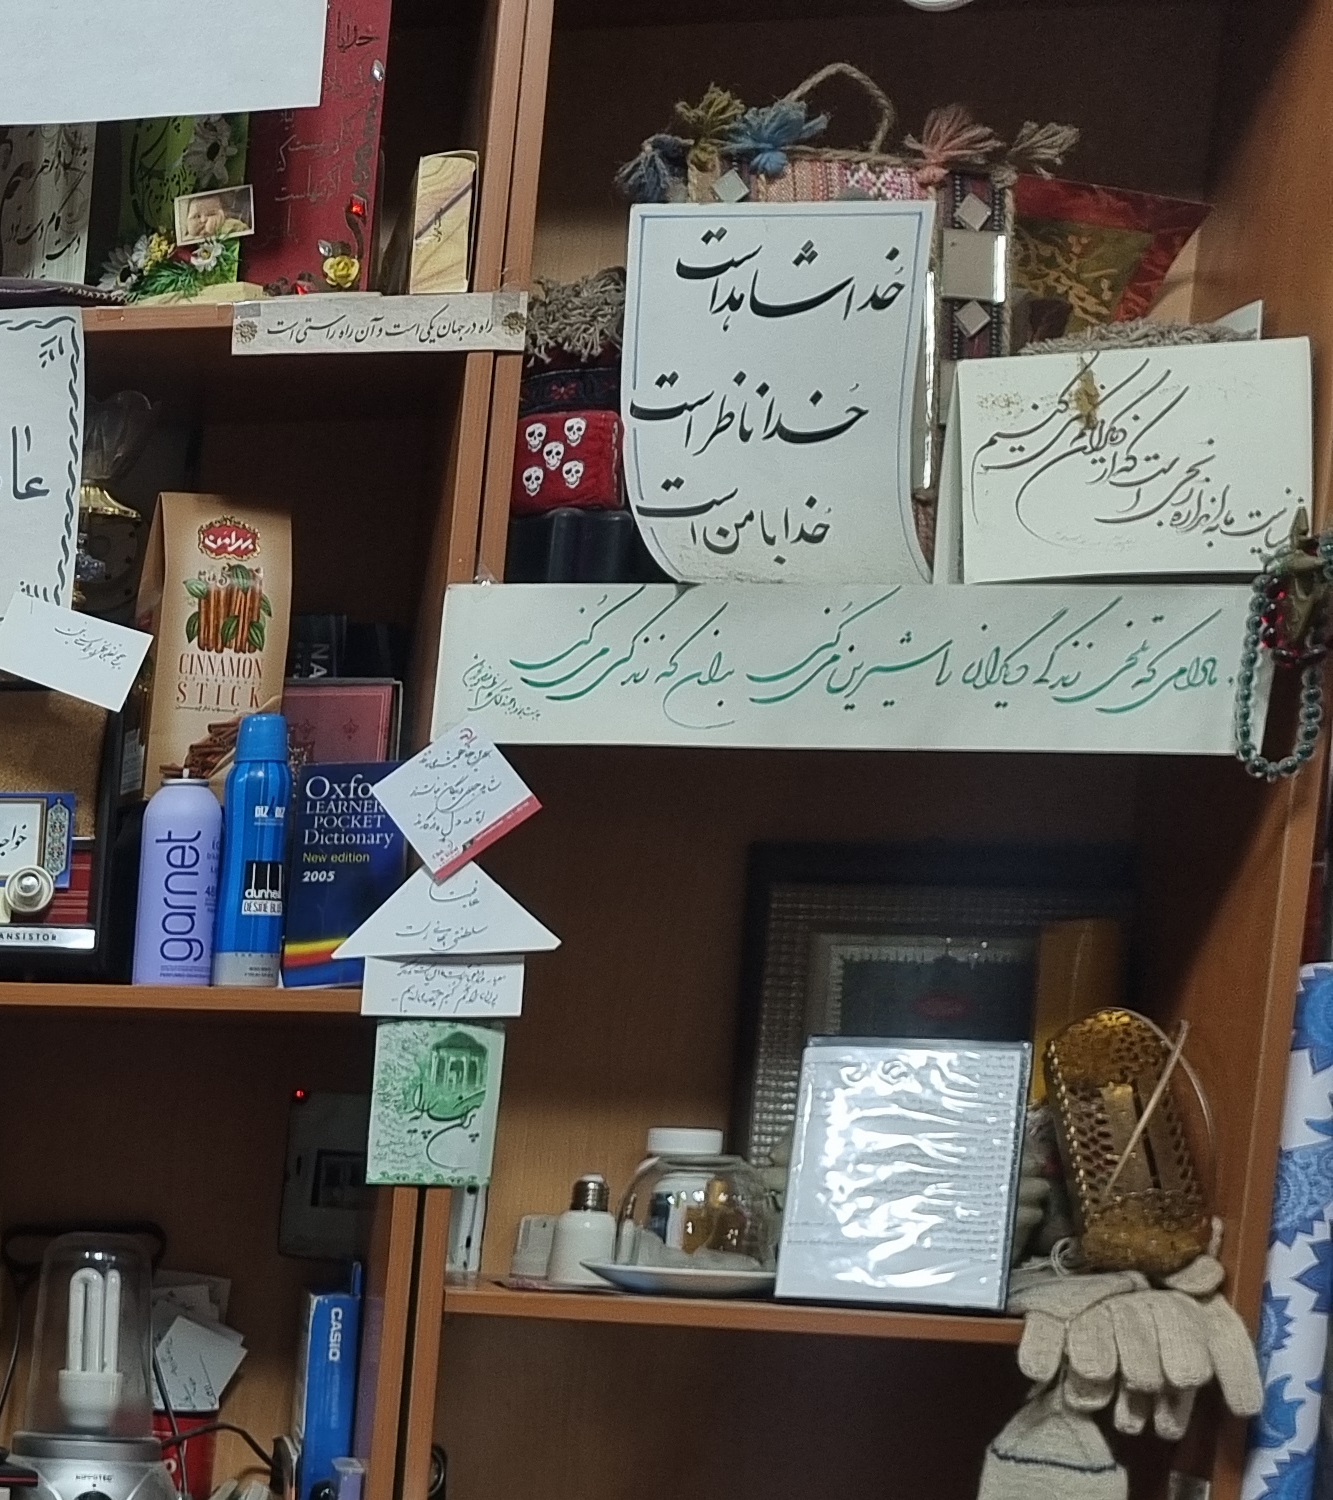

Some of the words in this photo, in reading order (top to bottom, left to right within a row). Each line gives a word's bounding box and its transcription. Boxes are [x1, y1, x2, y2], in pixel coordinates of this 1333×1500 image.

[843, 246, 906, 321] خدا
[266, 318, 297, 341] است
[385, 320, 419, 337] است
[436, 319, 466, 342] جهان
[692, 370, 770, 457] ناظر
[761, 382, 870, 445] خدا
[703, 508, 755, 555] من
[783, 495, 832, 545] خدا
[759, 508, 787, 565] با
[177, 652, 263, 680] CINNAMON
[175, 683, 263, 709] STICK
[304, 772, 374, 800] Oxfo
[305, 799, 385, 814] LEARNER
[313, 814, 386, 829] POCKET
[302, 829, 395, 848] Dictionary
[302, 852, 328, 863] New
[330, 851, 371, 863] edition
[301, 870, 335, 883] 2005
[154, 829, 204, 963] garnet
[328, 1306, 343, 1362] CASIO
